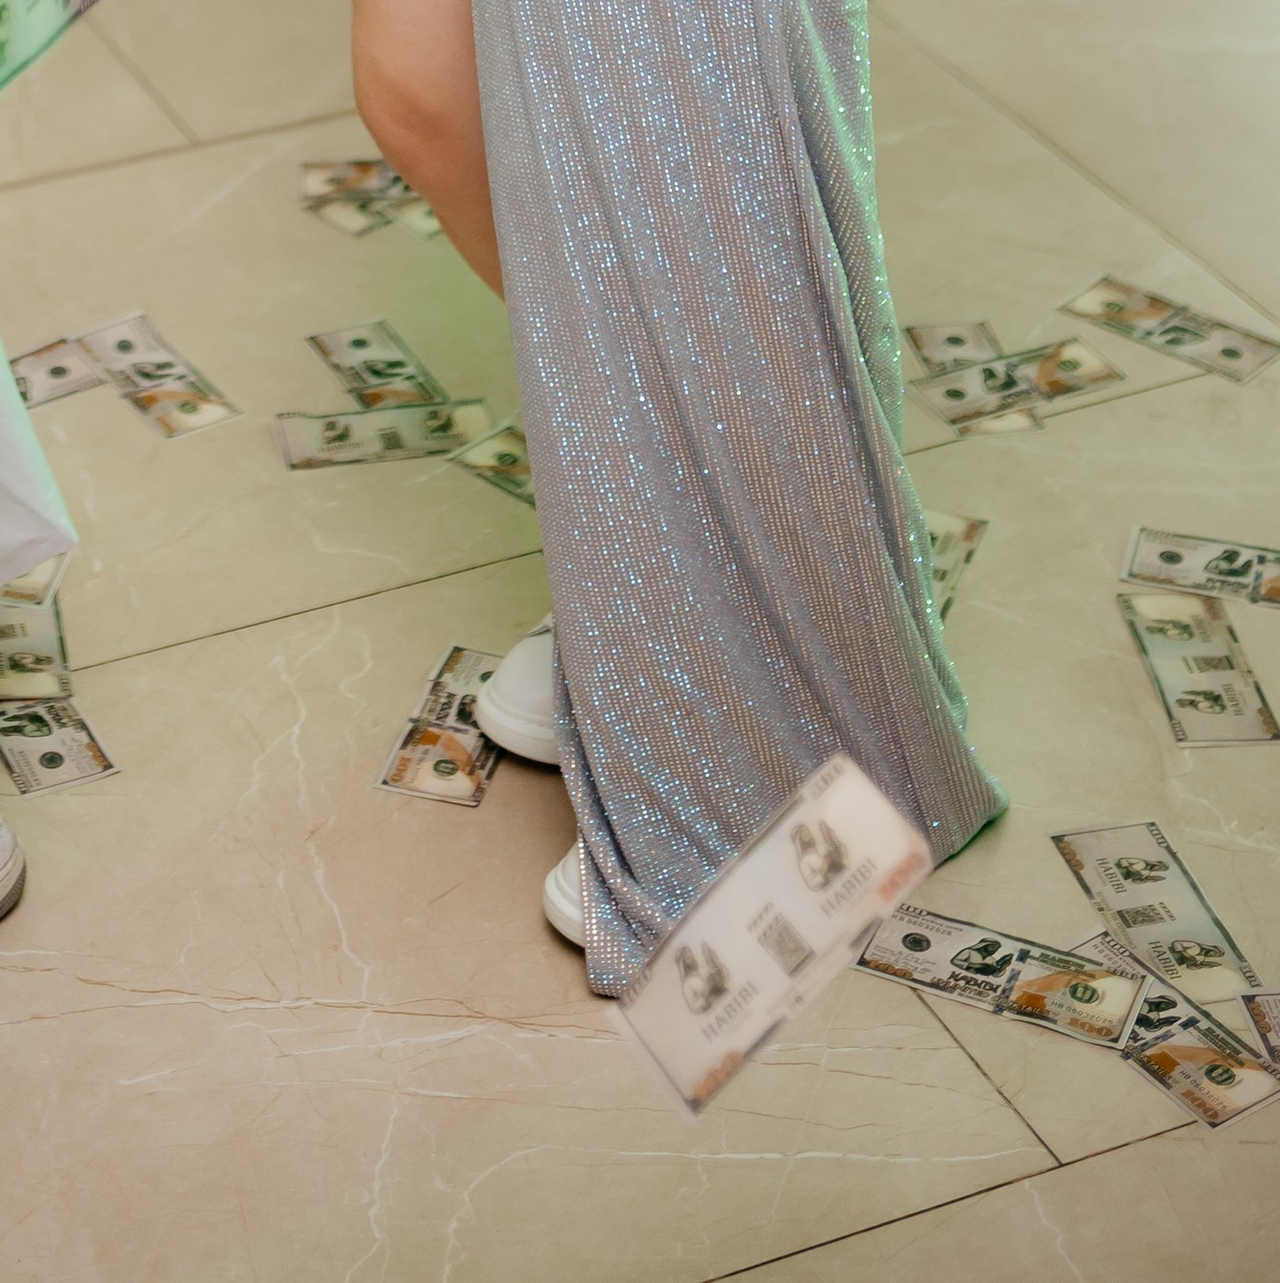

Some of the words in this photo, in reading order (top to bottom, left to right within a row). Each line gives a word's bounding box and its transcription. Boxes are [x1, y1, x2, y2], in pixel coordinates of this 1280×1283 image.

[819, 857, 879, 920] HABIBI
[1096, 857, 1128, 894] HABIBI
[906, 917, 953, 936] 06032026
[867, 958, 914, 980] 100
[1148, 940, 1182, 980] HABIBI
[701, 981, 760, 1044] HABIBI
[1065, 1005, 1114, 1026] 06032026
[1067, 1016, 1114, 1039] 100
[1179, 1086, 1221, 1122] 100
[1188, 1077, 1229, 1111] 06032026
